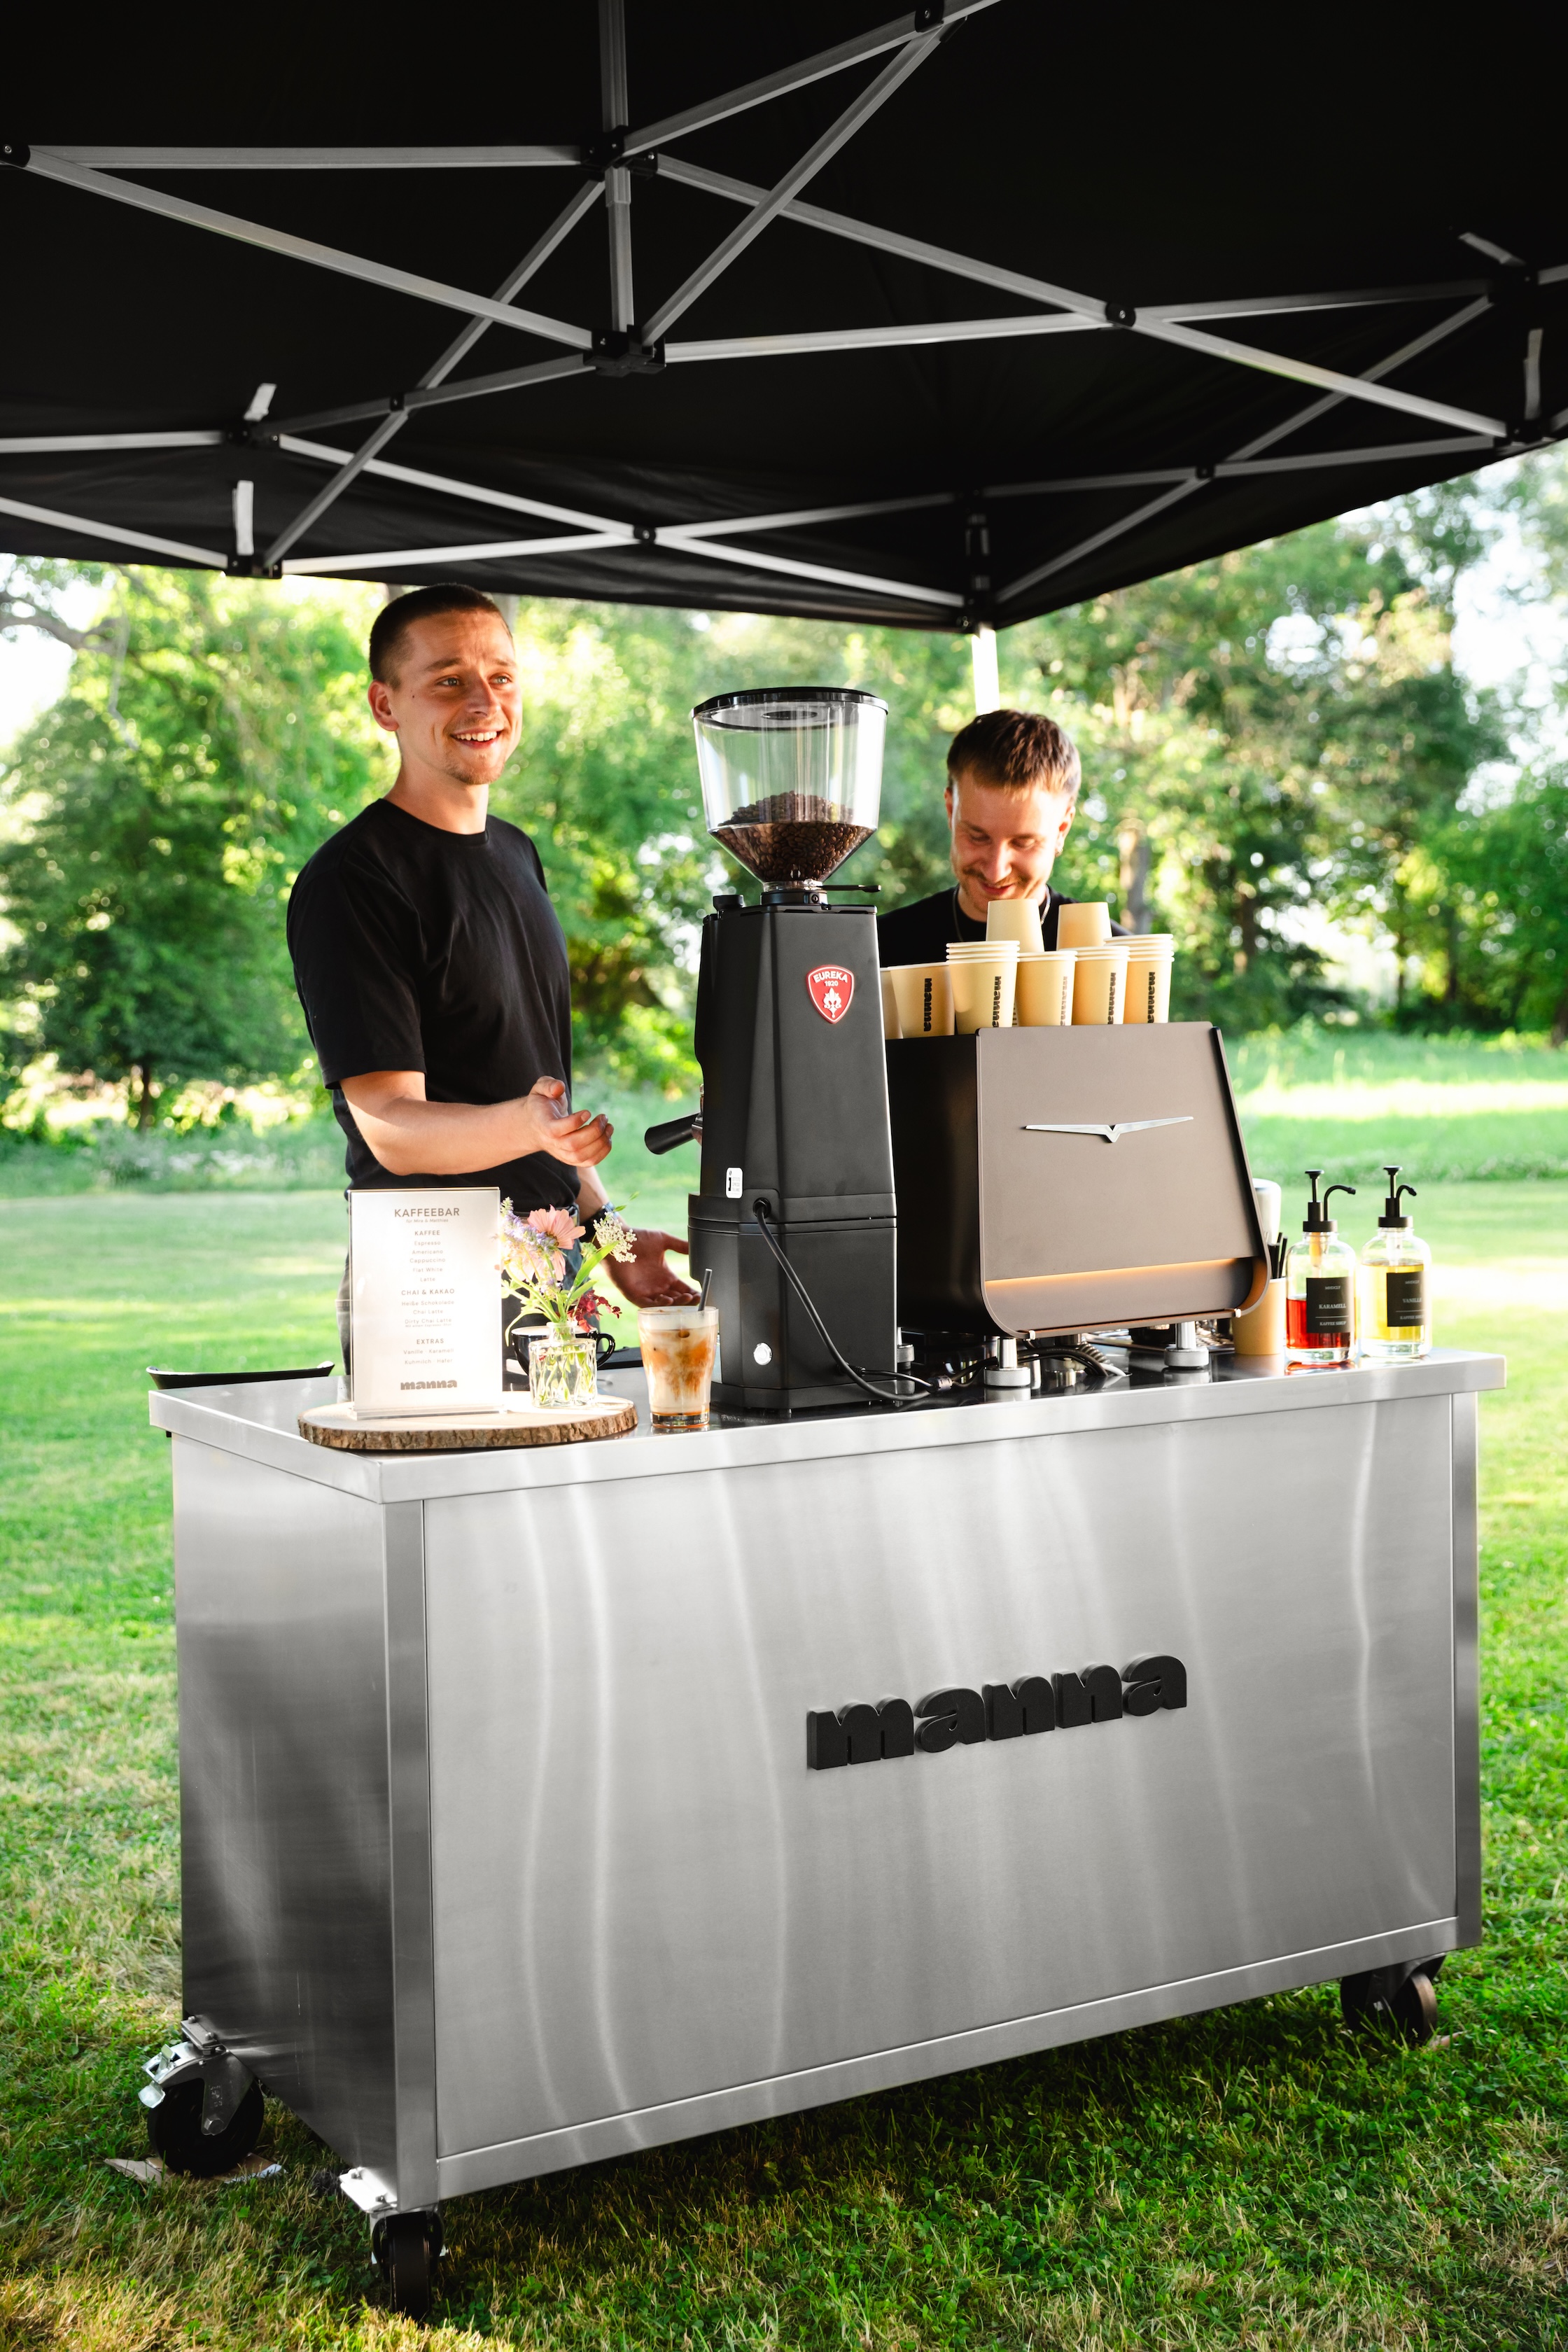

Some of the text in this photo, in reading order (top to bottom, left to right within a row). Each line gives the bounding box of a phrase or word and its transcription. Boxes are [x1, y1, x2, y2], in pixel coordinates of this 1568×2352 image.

[813, 971, 848, 983] EUREKA
[1107, 972, 1116, 1024] manna
[1147, 972, 1156, 1023] manna
[923, 978, 932, 1032] manna
[394, 1208, 460, 1217] KAFFEEBAR
[400, 1380, 458, 1390] manna
[807, 1653, 1187, 1770] manna
